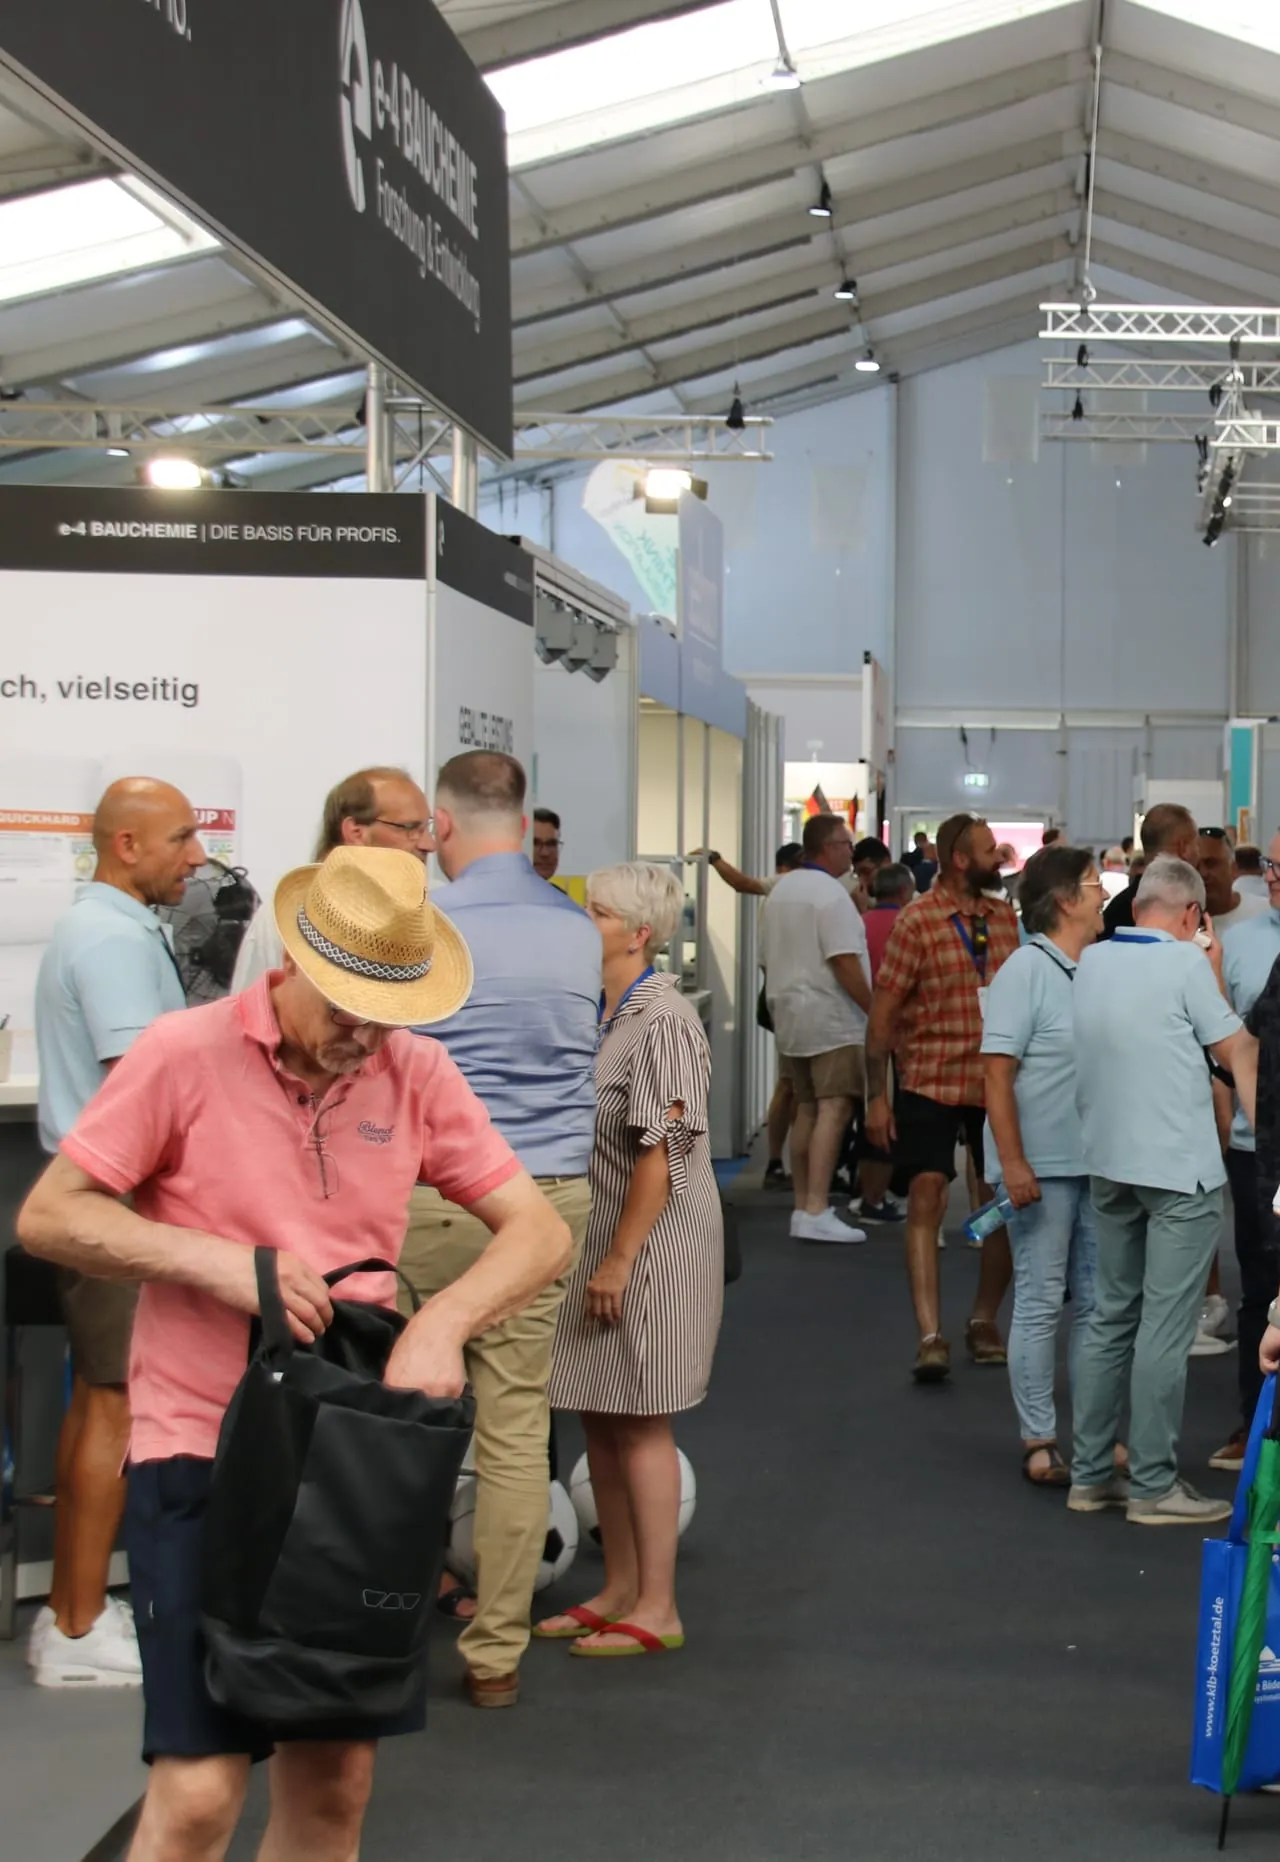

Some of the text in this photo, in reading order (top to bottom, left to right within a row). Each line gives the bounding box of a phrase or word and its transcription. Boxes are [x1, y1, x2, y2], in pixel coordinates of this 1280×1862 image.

[402, 70, 479, 240] BAUCHEMIE
[376, 156, 426, 279] Forschung
[58, 520, 401, 544] e-4 BAUCHEMIE DIE BASIS FÜR PROFIS.
[57, 675, 200, 709] vielseitig
[1205, 1596, 1224, 1738] www.klb-koetztal.de
